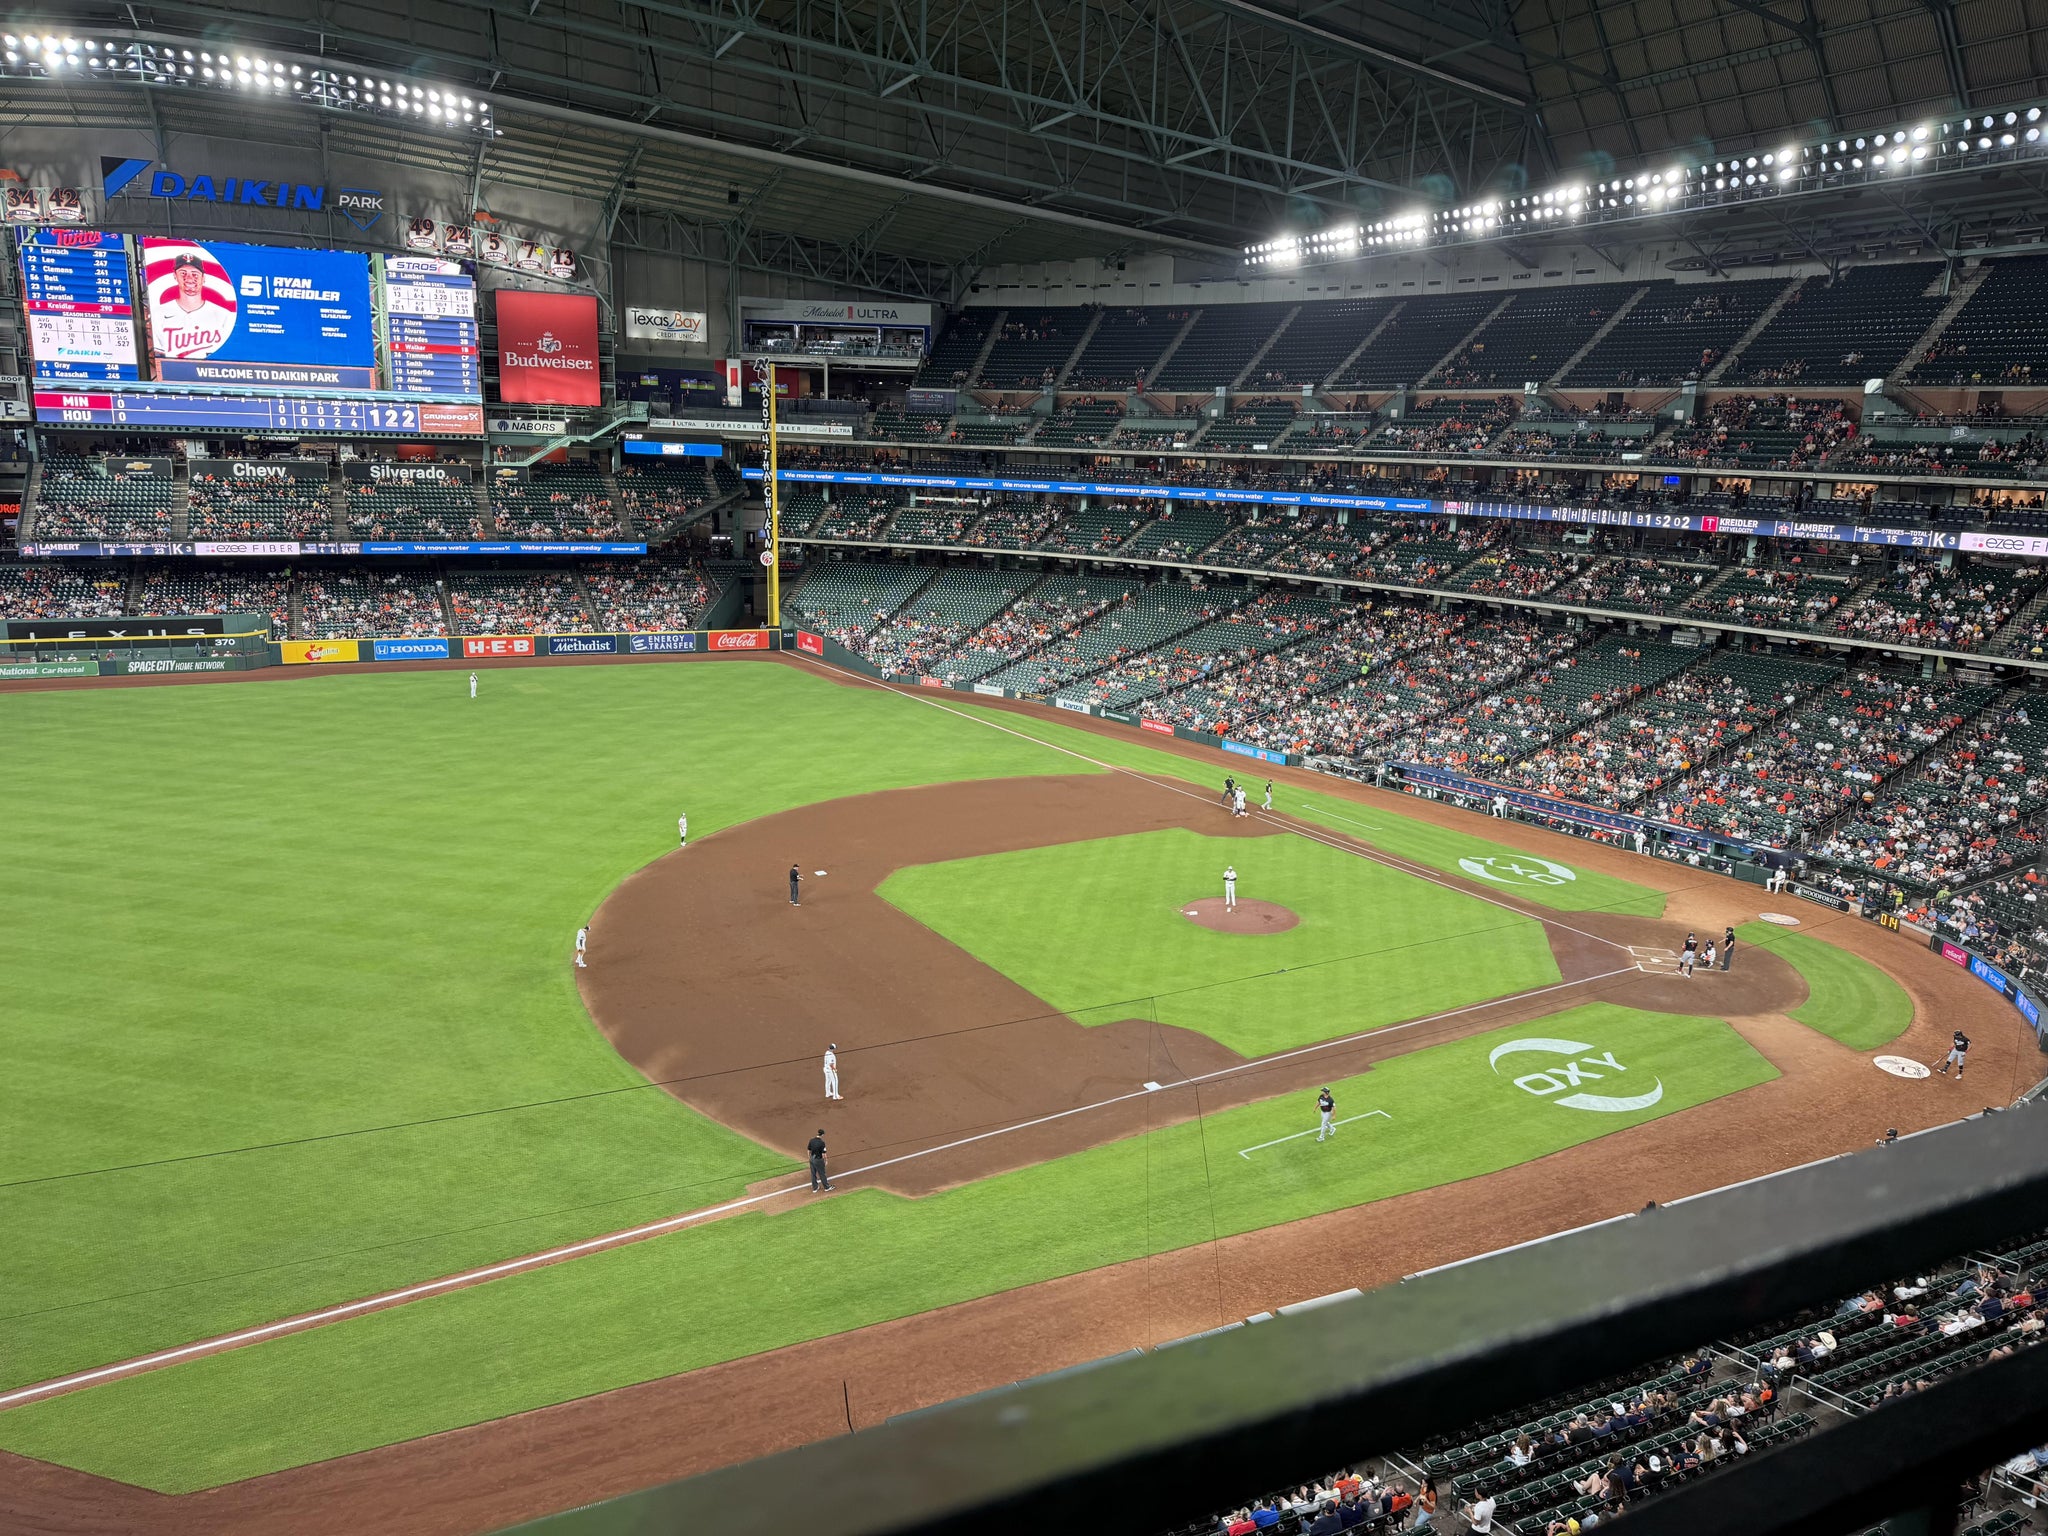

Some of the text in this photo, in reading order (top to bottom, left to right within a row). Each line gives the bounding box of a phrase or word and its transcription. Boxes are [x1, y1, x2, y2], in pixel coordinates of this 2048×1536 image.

[150, 170, 325, 211] DAIKIN
[7, 187, 37, 209] 34
[49, 187, 79, 209] 42
[339, 195, 385, 210] PARK
[410, 218, 435, 236] 49
[51, 229, 103, 248] Twins
[445, 225, 472, 244] 24
[489, 232, 500, 251] 5
[522, 241, 536, 259] 7
[553, 250, 575, 267] 13
[397, 262, 438, 271] STROS
[240, 275, 263, 297] 5
[273, 276, 312, 289] RYAN
[273, 288, 340, 302] KREIDLER
[802, 306, 898, 320] Michelob ULTRA
[631, 310, 702, 333] Texas Bay
[163, 326, 222, 352] Twins
[656, 331, 700, 341] CREDIT UNION
[196, 367, 340, 383] WELCOME TO DAIKIN PARK
[63, 396, 89, 407] MIN
[63, 410, 92, 421] HOU
[369, 409, 415, 428] 1 2 2
[511, 422, 556, 431] NABORS
[233, 462, 287, 478] Chevy
[370, 465, 446, 479] Silverado
[760, 385, 773, 549] ROOT THA CHIKIN
[926, 478, 957, 486] gameday
[1113, 487, 1140, 495] powers
[1141, 488, 1170, 497] gameday
[1355, 499, 1386, 508] gameday
[1720, 519, 1758, 528] KREIDLER
[1794, 523, 1835, 533] LAMBERT
[1912, 537, 1924, 545] 23
[1933, 532, 1956, 547] K 3
[1986, 538, 2025, 550] ezee
[173, 544, 183, 554] K
[216, 545, 248, 553] ezee
[252, 545, 293, 553] FIBER
[648, 633, 685, 642] ENERGY
[717, 633, 758, 648] Coca-Cola
[390, 644, 447, 653] HONDA
[554, 640, 611, 653] Methodist
[649, 641, 694, 650] TRANSFER
[57, 666, 85, 674] Rental
[128, 660, 226, 673] SPACE CITY HOME NETWORK
[1468, 856, 1566, 886] OXY
[1803, 887, 1841, 906] WOODFOREST
[1945, 949, 1962, 960] reliant
[1988, 969, 2003, 987] Texas
[1513, 1051, 1628, 1096] OXY
